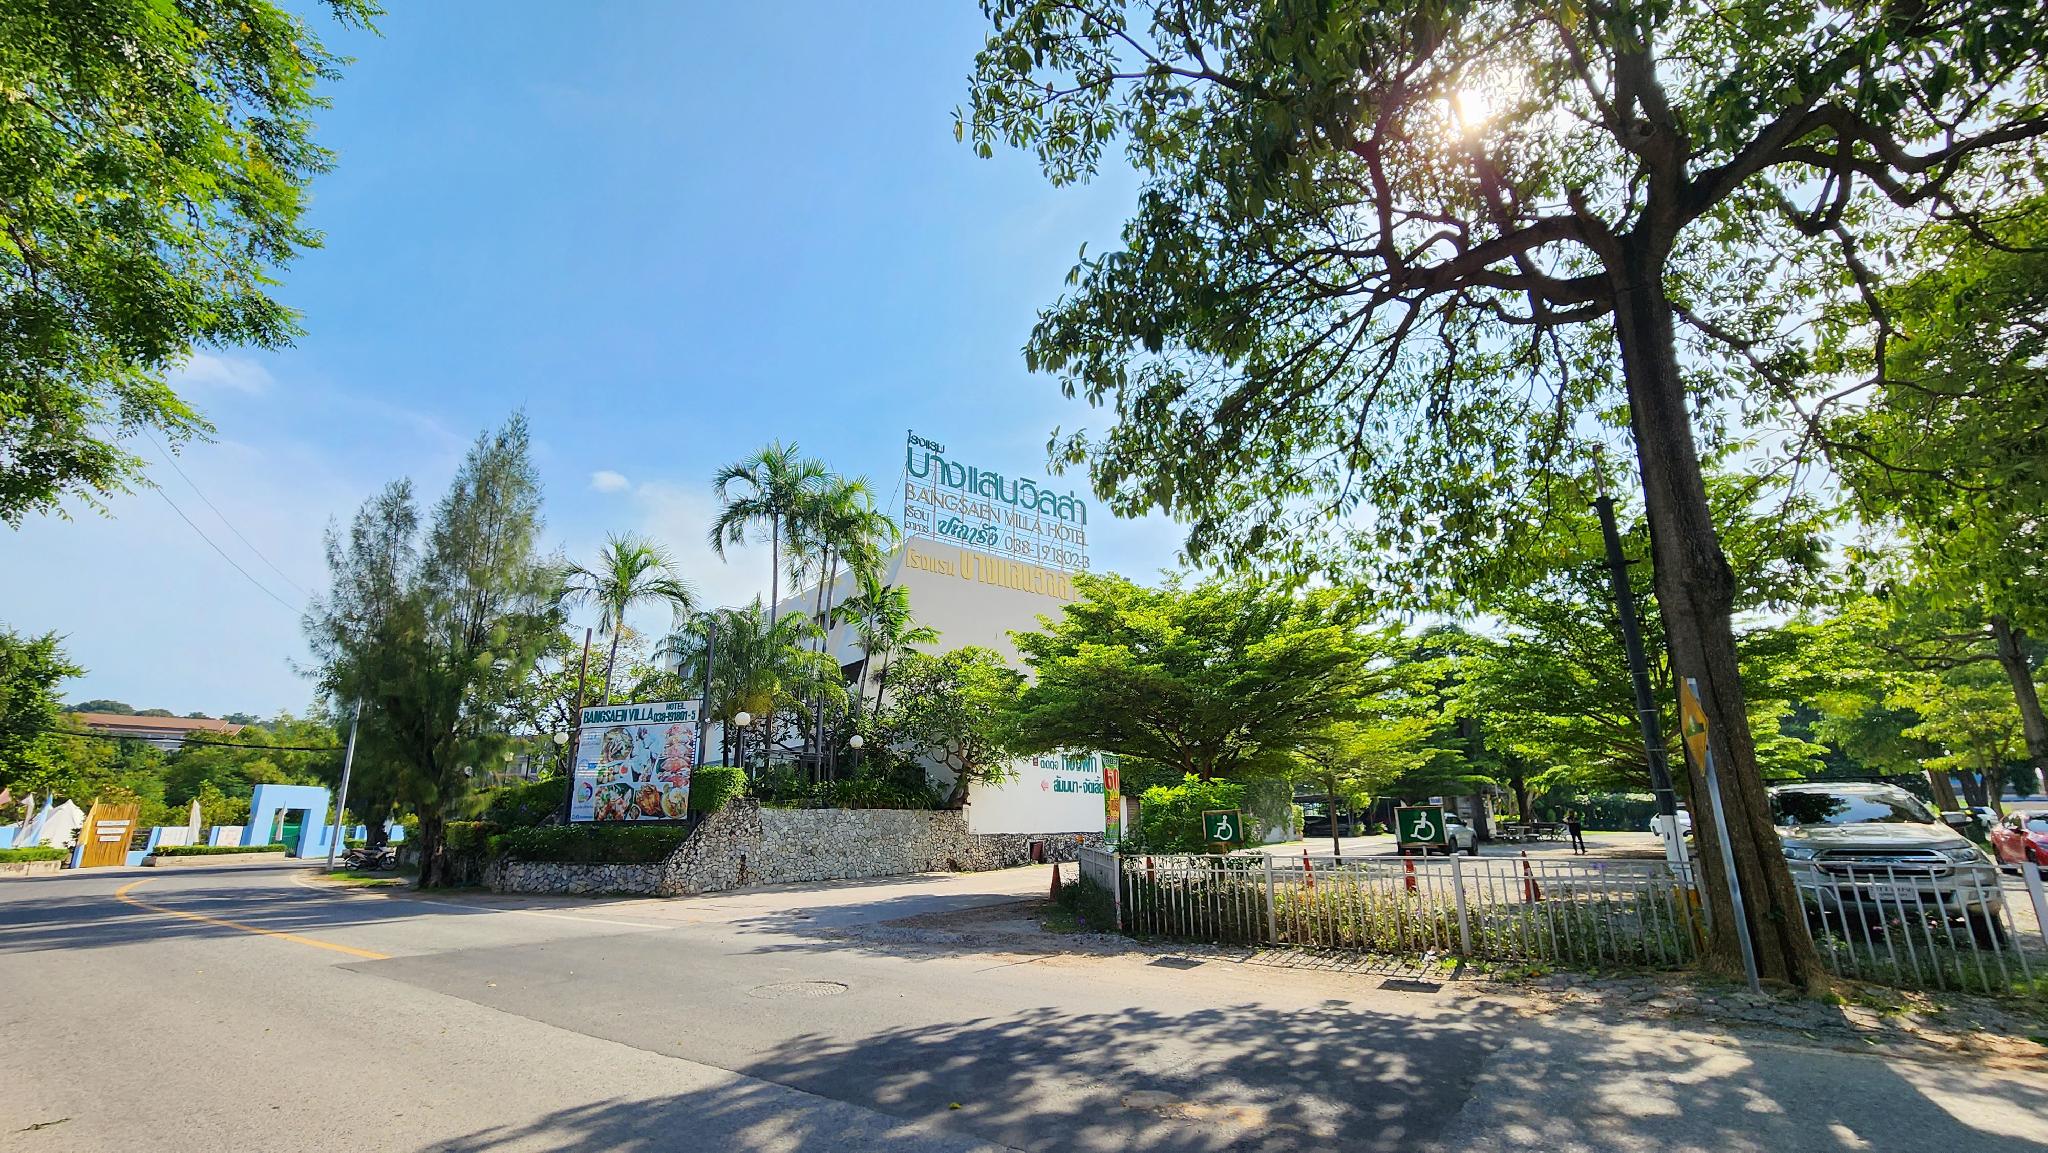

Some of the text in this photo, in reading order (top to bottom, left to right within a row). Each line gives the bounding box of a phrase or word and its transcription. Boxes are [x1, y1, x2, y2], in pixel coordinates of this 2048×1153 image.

[907, 429, 945, 453] โรงแรม
[907, 447, 1087, 525] บางแสนวิลล่า
[905, 483, 1088, 546] BANGSAEN VILLA HOTEL
[906, 547, 955, 577] โรงแรม
[583, 709, 628, 723] BANGSAEN
[629, 708, 653, 721] VILLA
[1061, 754, 1098, 773] หองพก
